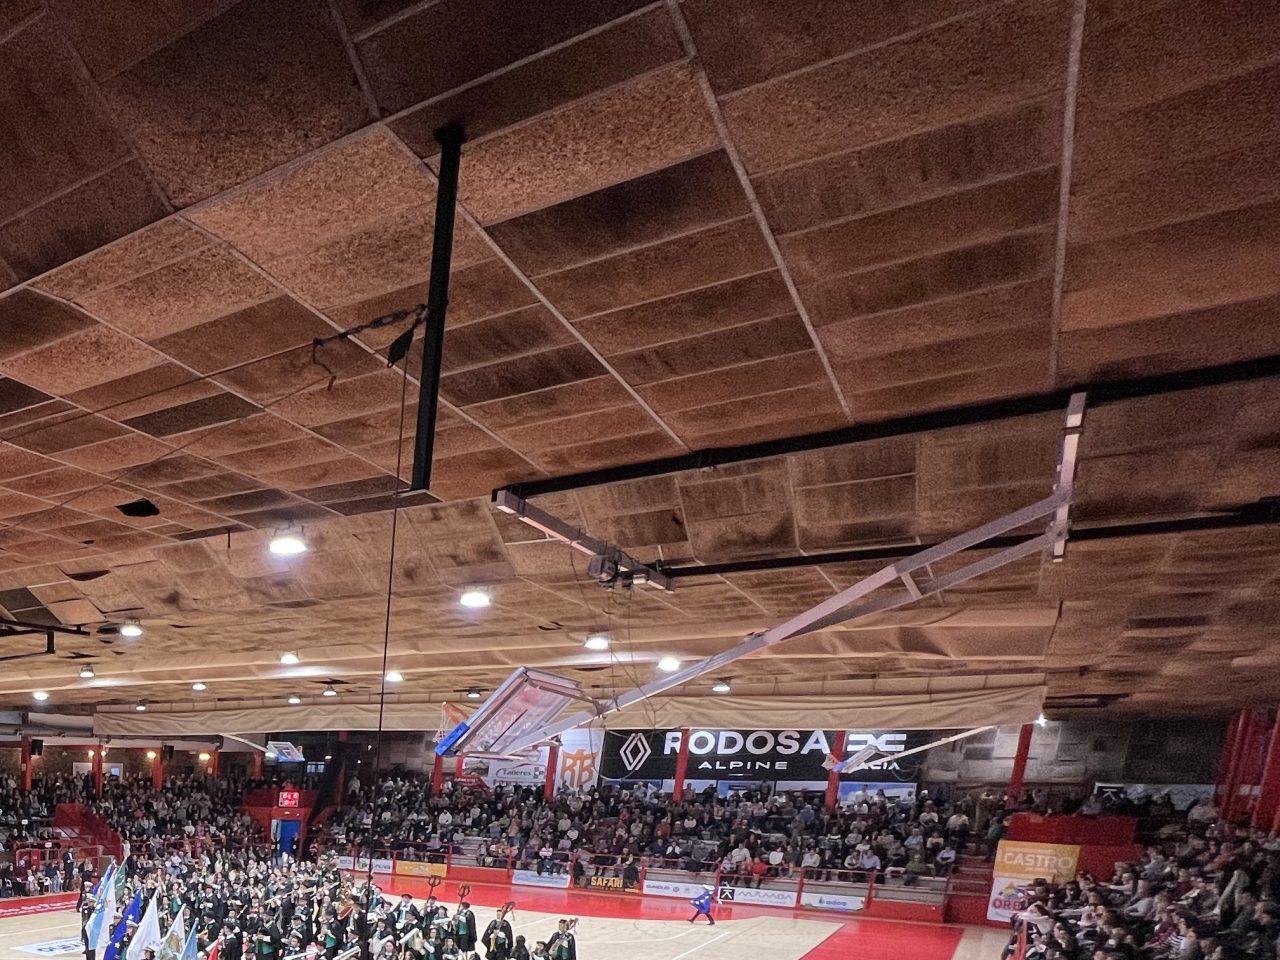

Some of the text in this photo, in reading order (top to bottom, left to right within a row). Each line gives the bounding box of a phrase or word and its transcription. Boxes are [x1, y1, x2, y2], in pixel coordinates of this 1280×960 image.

[663, 730, 831, 755] RODOSA
[698, 760, 788, 770] ALPINE
[1003, 852, 1073, 869] CASTRO
[590, 876, 624, 888] SAFARI
